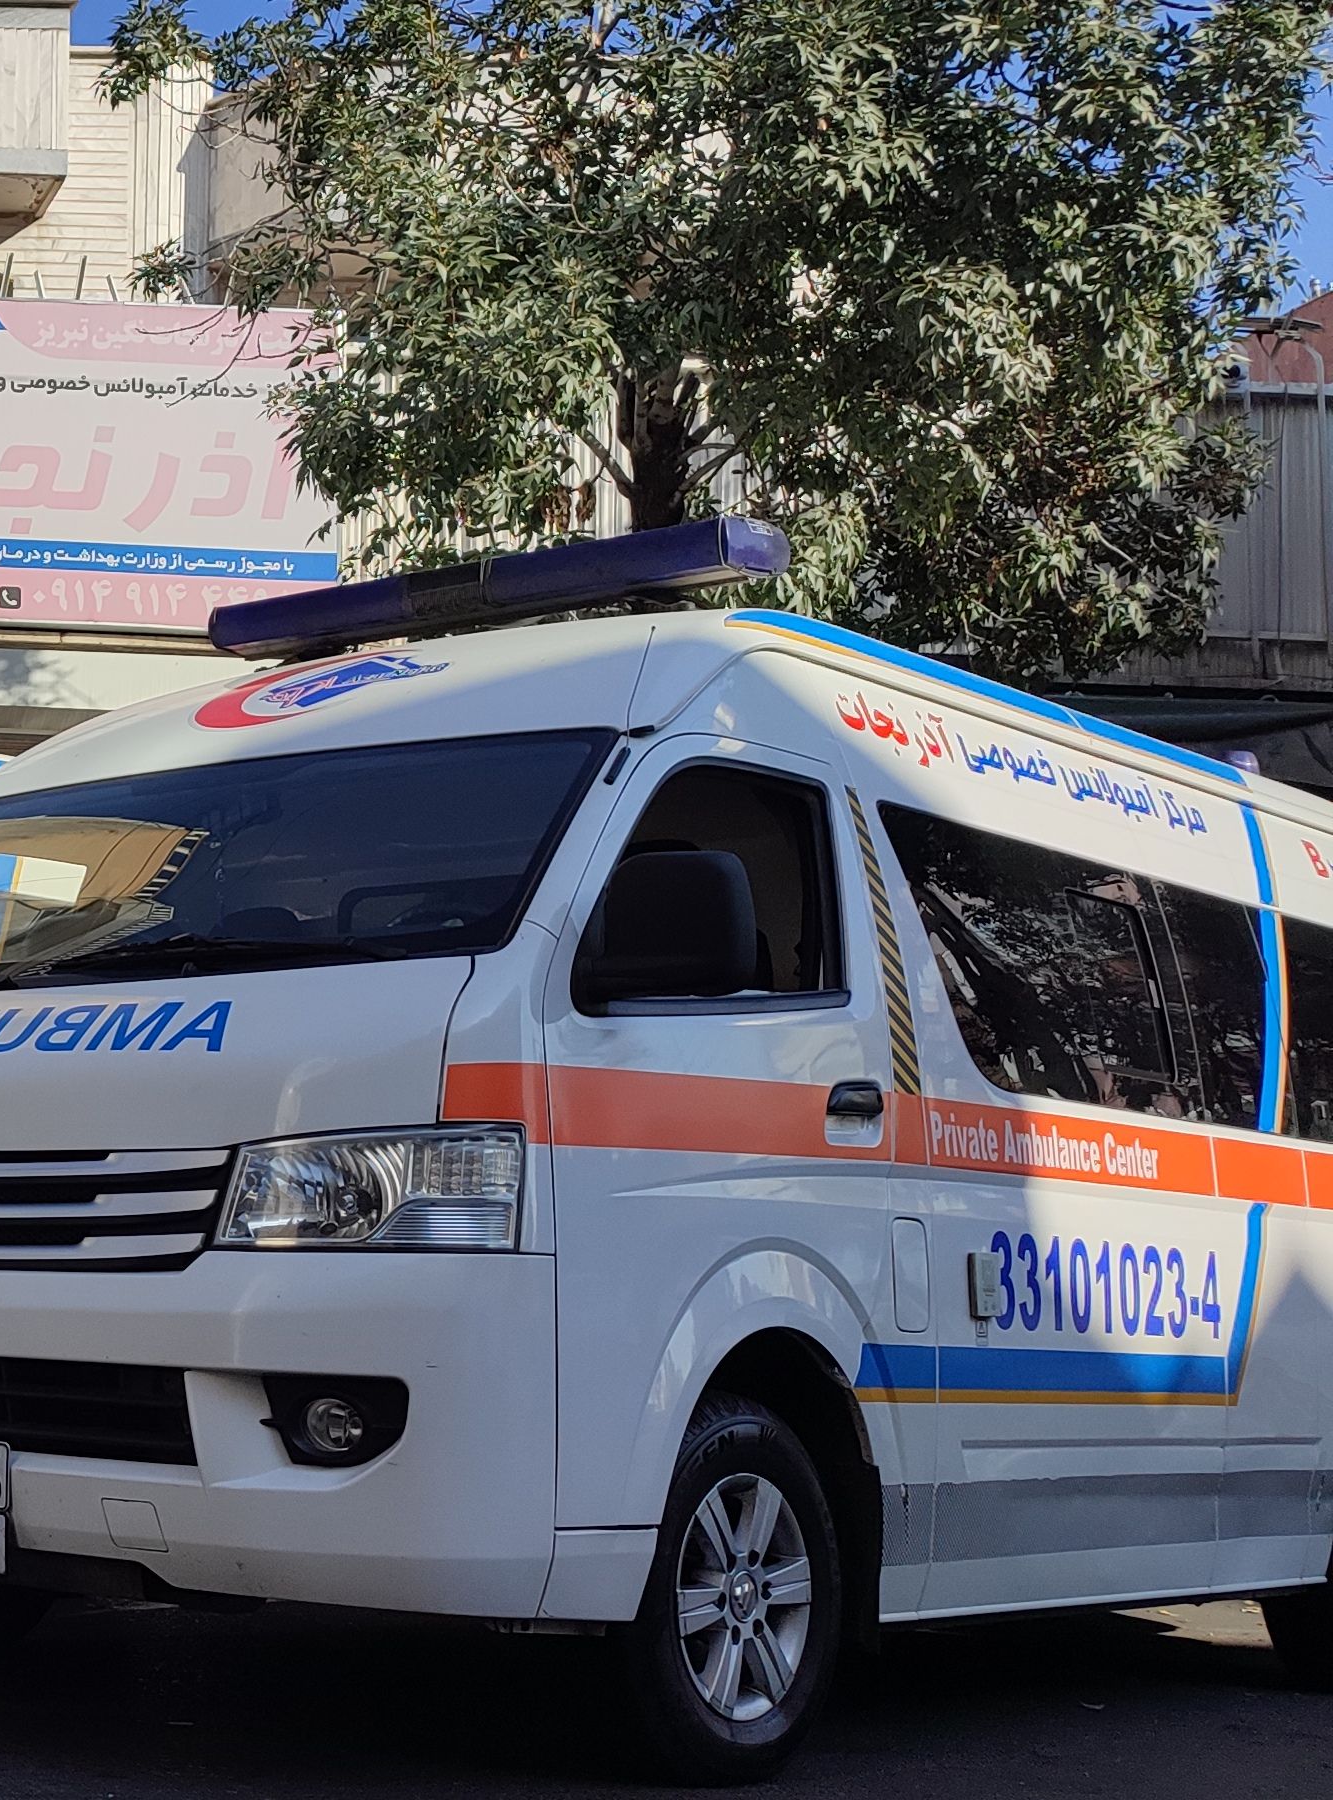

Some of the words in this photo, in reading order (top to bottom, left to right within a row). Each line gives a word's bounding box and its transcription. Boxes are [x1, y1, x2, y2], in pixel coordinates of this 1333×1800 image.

[32, 317, 90, 349] تبریز
[10, 374, 91, 395] خصوصی
[92, 376, 188, 400] آمبولانس
[42, 551, 52, 564] و
[52, 547, 121, 568] بهداشت
[121, 551, 168, 570] وزارت
[168, 552, 182, 571] از
[183, 556, 236, 573] رسمی
[237, 555, 281, 576] مجوز
[282, 557, 295, 576] با
[956, 731, 1058, 786] خصوصی
[1057, 764, 1161, 823] آمبولانس
[1157, 788, 1208, 836] مرکز
[929, 1110, 1000, 1162] Private
[1003, 1119, 1102, 1174] Ambulance
[1103, 1132, 1159, 1180] Center
[989, 1230, 1222, 1341] 33101023-4
